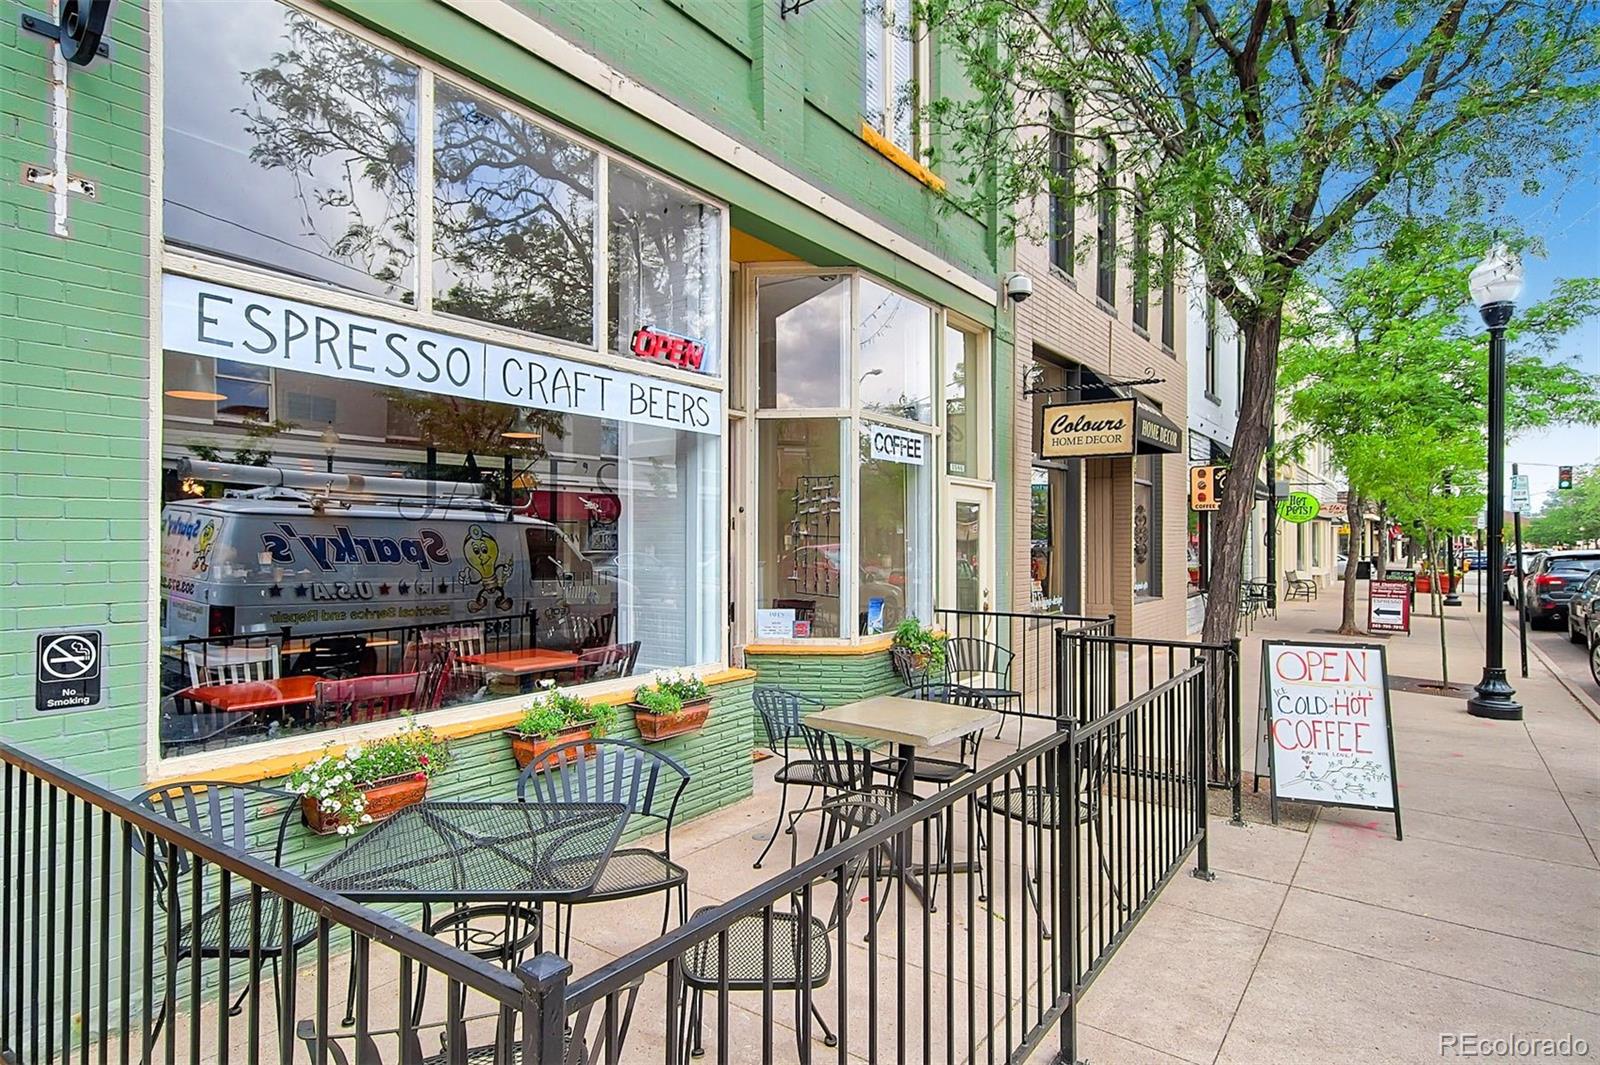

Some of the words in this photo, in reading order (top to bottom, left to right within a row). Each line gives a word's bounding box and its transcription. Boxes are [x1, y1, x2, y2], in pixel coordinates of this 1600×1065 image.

[196, 292, 472, 388] ESPRESSO
[502, 357, 614, 412] CRAFT
[628, 383, 711, 428] BEERS
[633, 329, 705, 370] OPEN
[1050, 414, 1127, 435] Colours
[1141, 419, 1159, 440] HOME
[1159, 427, 1178, 447] DECOR
[873, 432, 922, 459] COFFEE
[1052, 435, 1083, 447] HOME
[1085, 434, 1123, 444] DECOR
[1276, 650, 1368, 684] OPEN
[47, 696, 90, 708] Smoking
[61, 688, 77, 697] No
[1272, 718, 1373, 755] COFFEE
